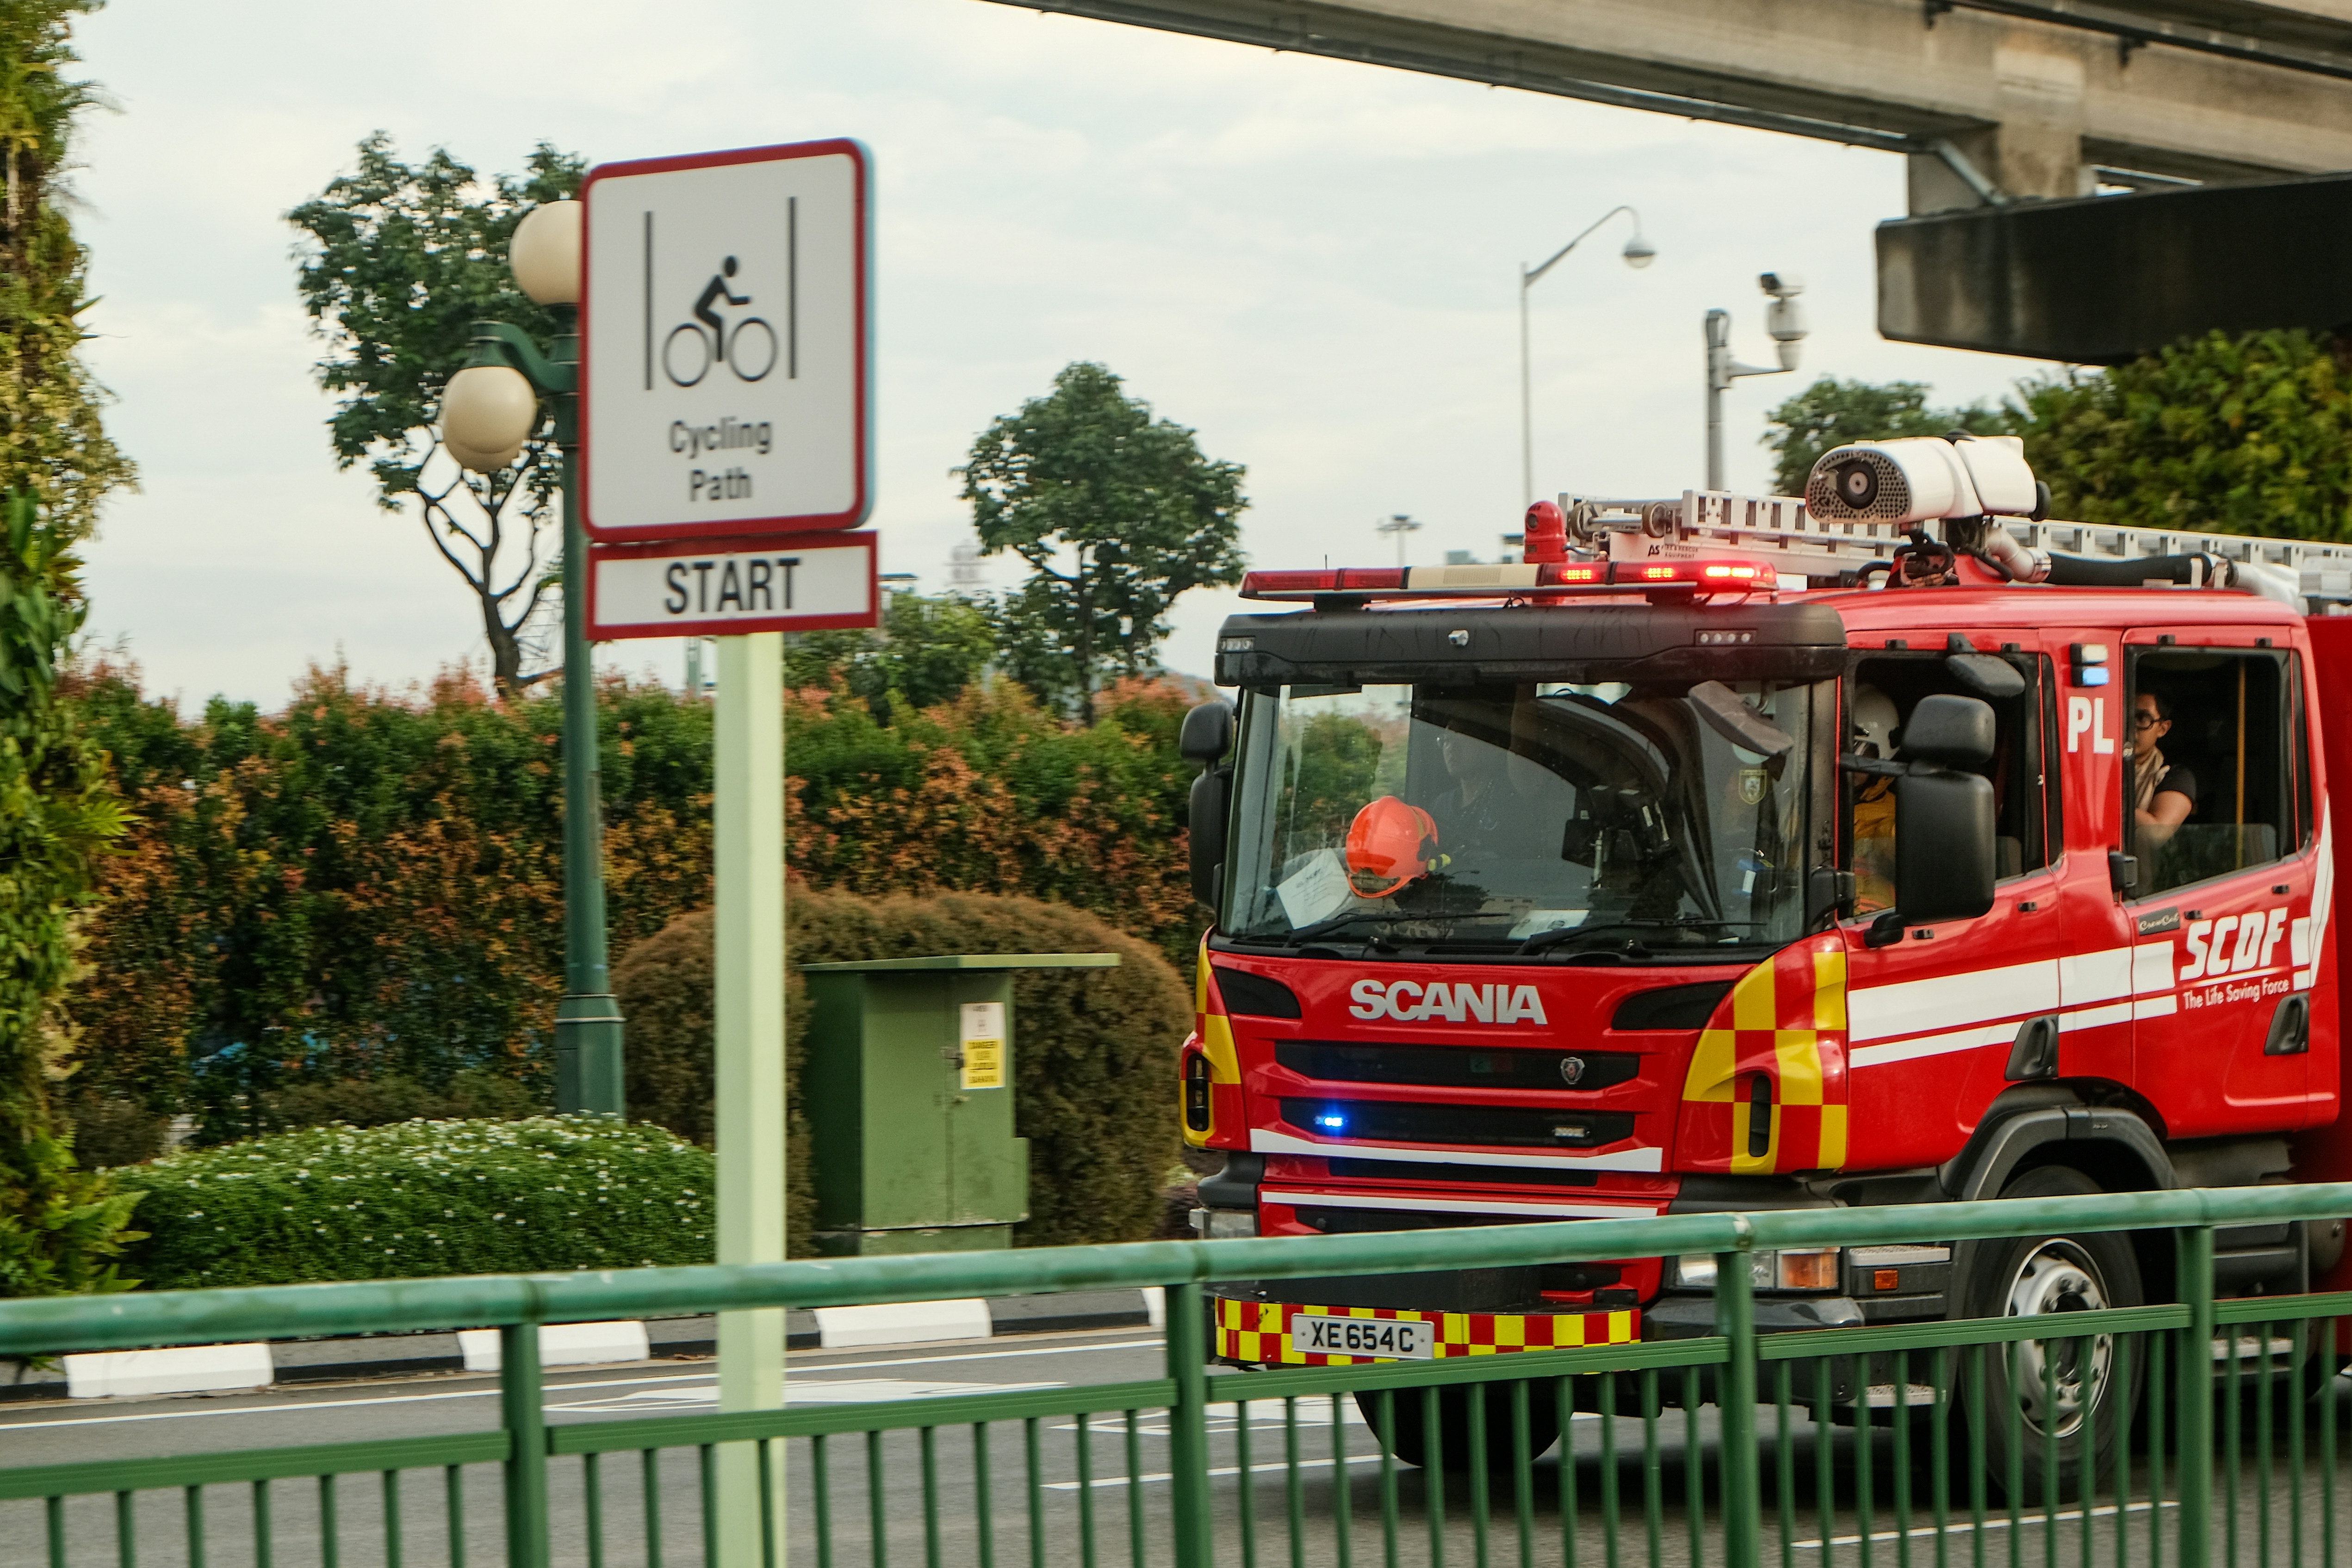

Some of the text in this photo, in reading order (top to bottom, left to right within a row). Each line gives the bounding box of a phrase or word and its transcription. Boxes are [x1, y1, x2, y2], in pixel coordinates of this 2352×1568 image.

[669, 415, 772, 459] Cycling
[689, 465, 753, 501] Path
[665, 557, 801, 614] START
[2068, 696, 2114, 754] PL
[2179, 907, 2288, 981] SCDF
[1348, 979, 1548, 1025] SCANIA
[2183, 977, 2290, 1010] The Life Saving Force
[1311, 1321, 1414, 1352] XE654C
